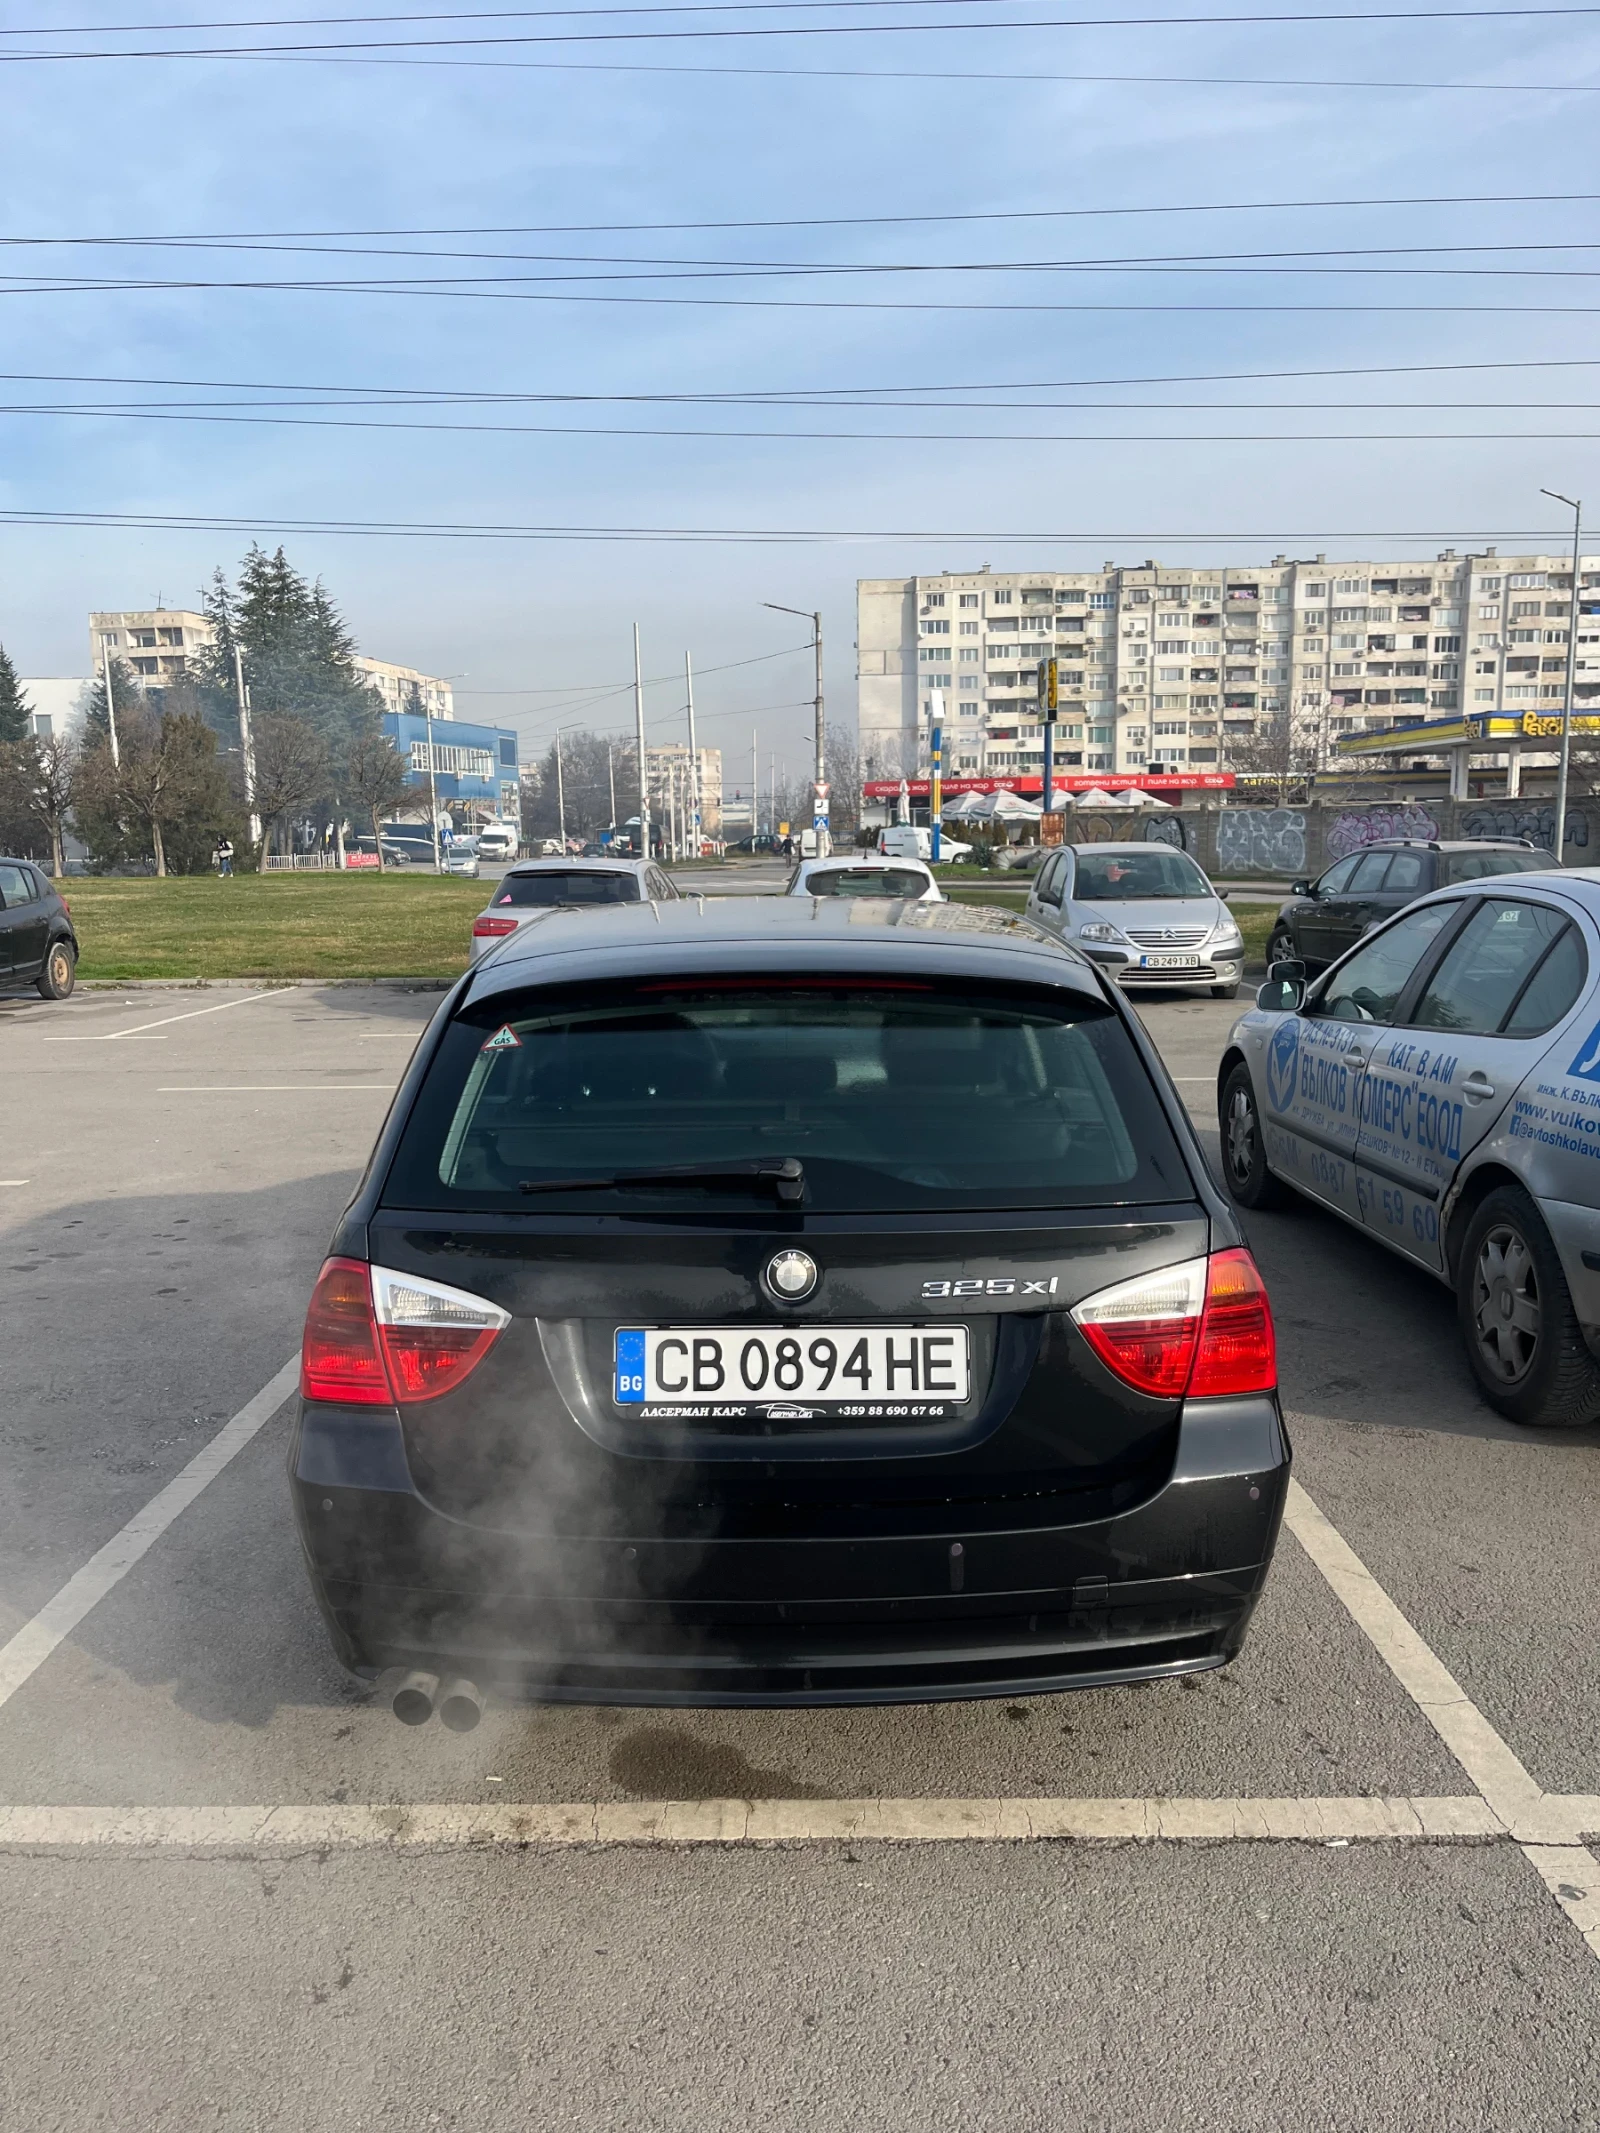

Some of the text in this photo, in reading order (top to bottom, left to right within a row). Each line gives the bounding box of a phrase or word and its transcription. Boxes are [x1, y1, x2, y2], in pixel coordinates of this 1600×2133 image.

[1147, 957, 1160, 967] CB
[1161, 957, 1183, 967] 2491
[494, 1036, 511, 1046] GAS
[1515, 1100, 1600, 1135] www.vulko
[1417, 1091, 1464, 1162] ЕООД
[1412, 1204, 1438, 1242] 60
[773, 1252, 812, 1268] BMW
[739, 1337, 873, 1392] 0894
[620, 1375, 642, 1392] BG
[640, 1406, 747, 1417] ЛАСЕРМАН КАРС
[837, 1405, 944, 1416] +359 88 690 67 66
